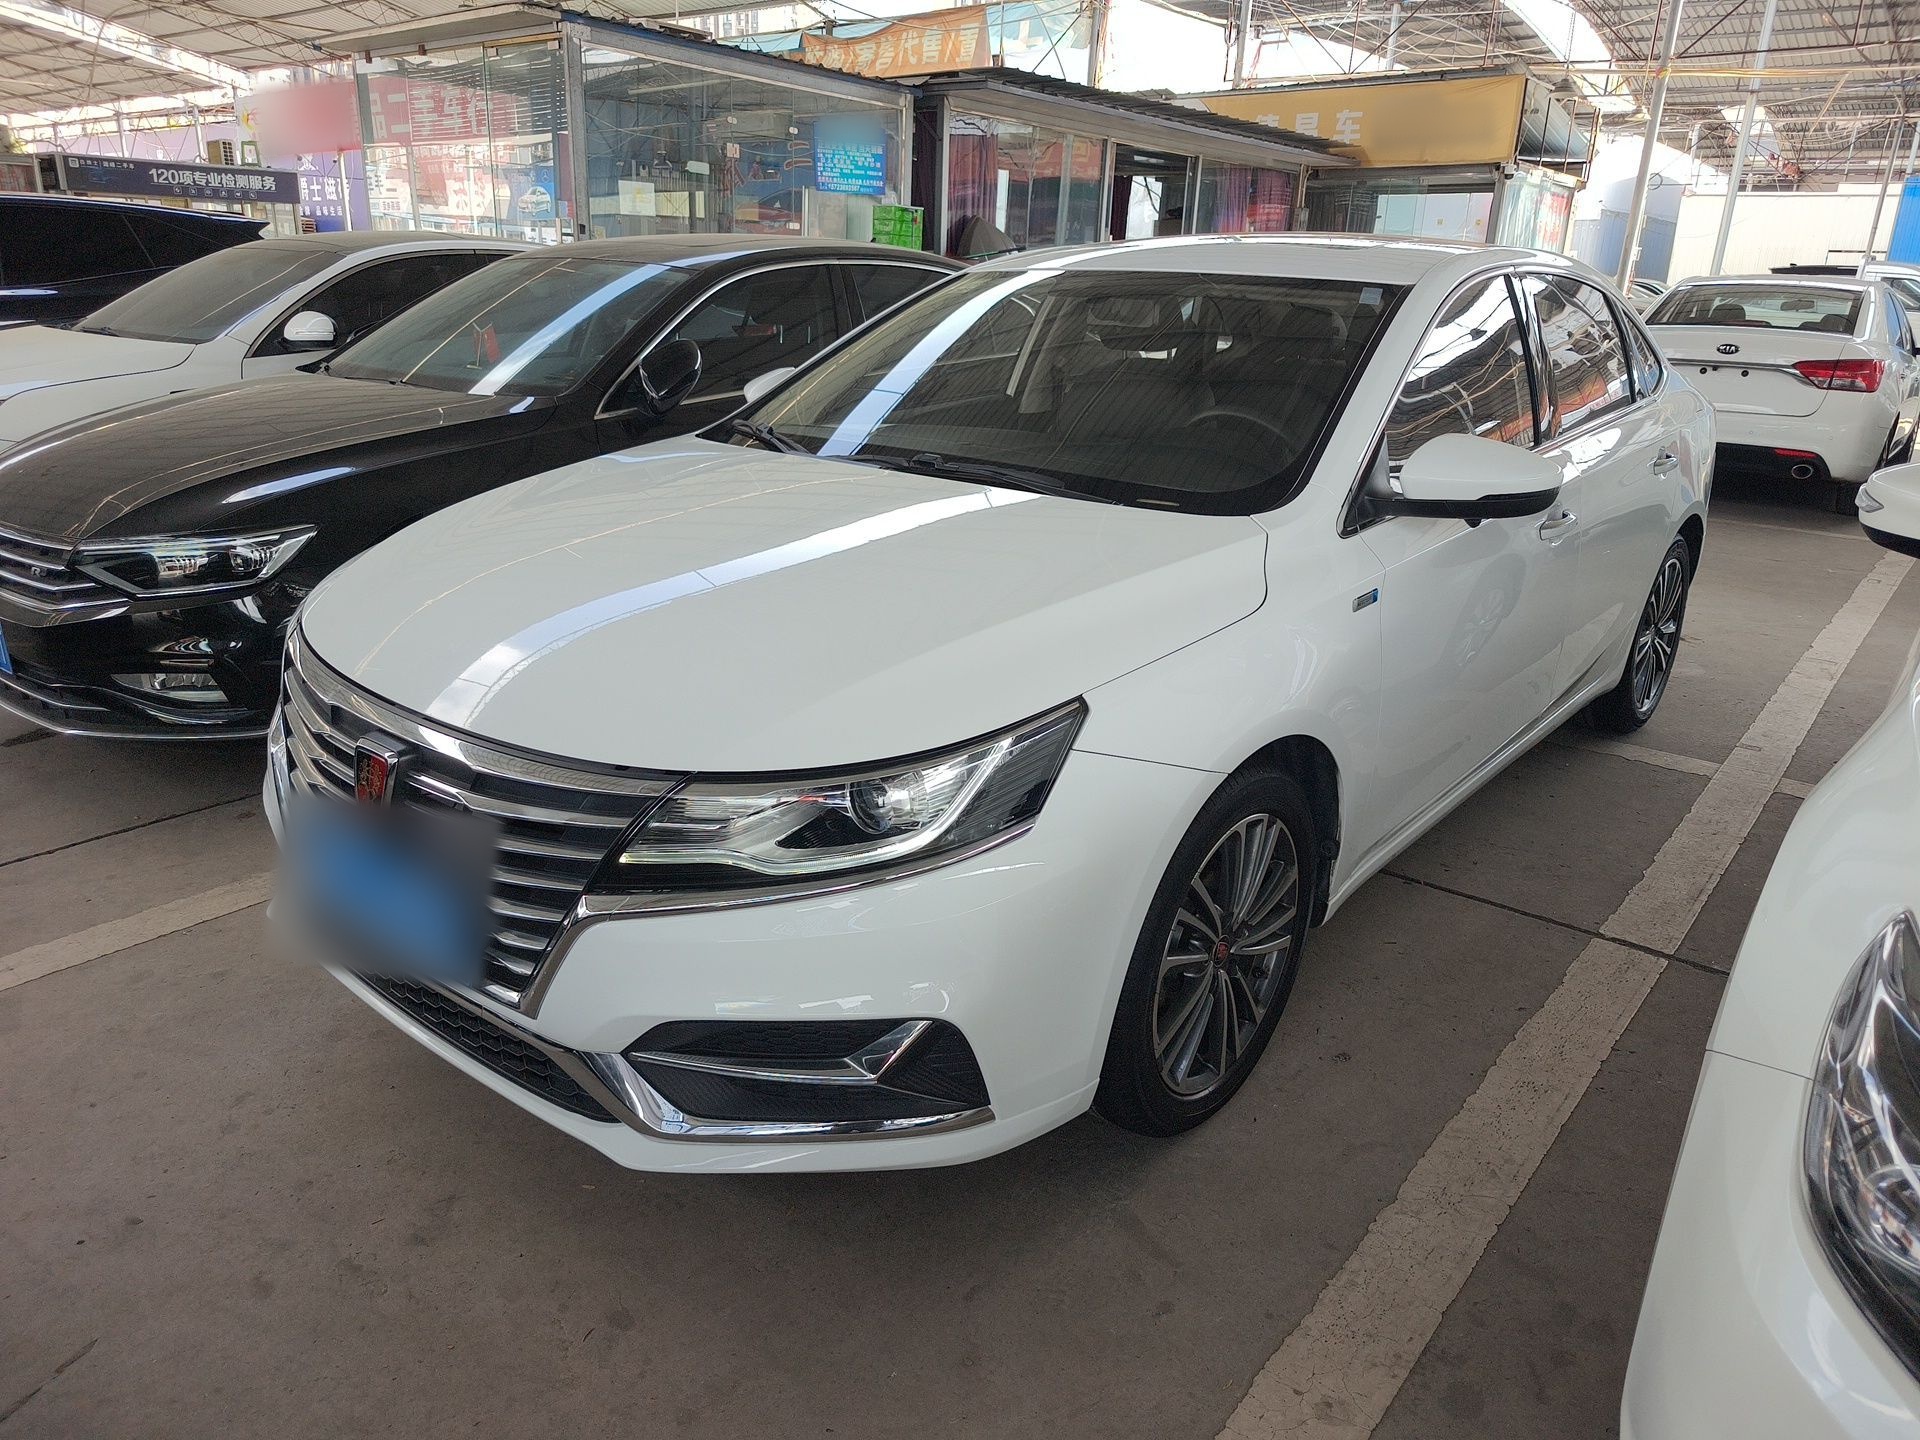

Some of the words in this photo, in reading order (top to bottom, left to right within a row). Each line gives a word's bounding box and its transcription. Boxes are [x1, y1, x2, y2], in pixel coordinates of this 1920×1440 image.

[148, 167, 277, 191] 120项专业检测服务
